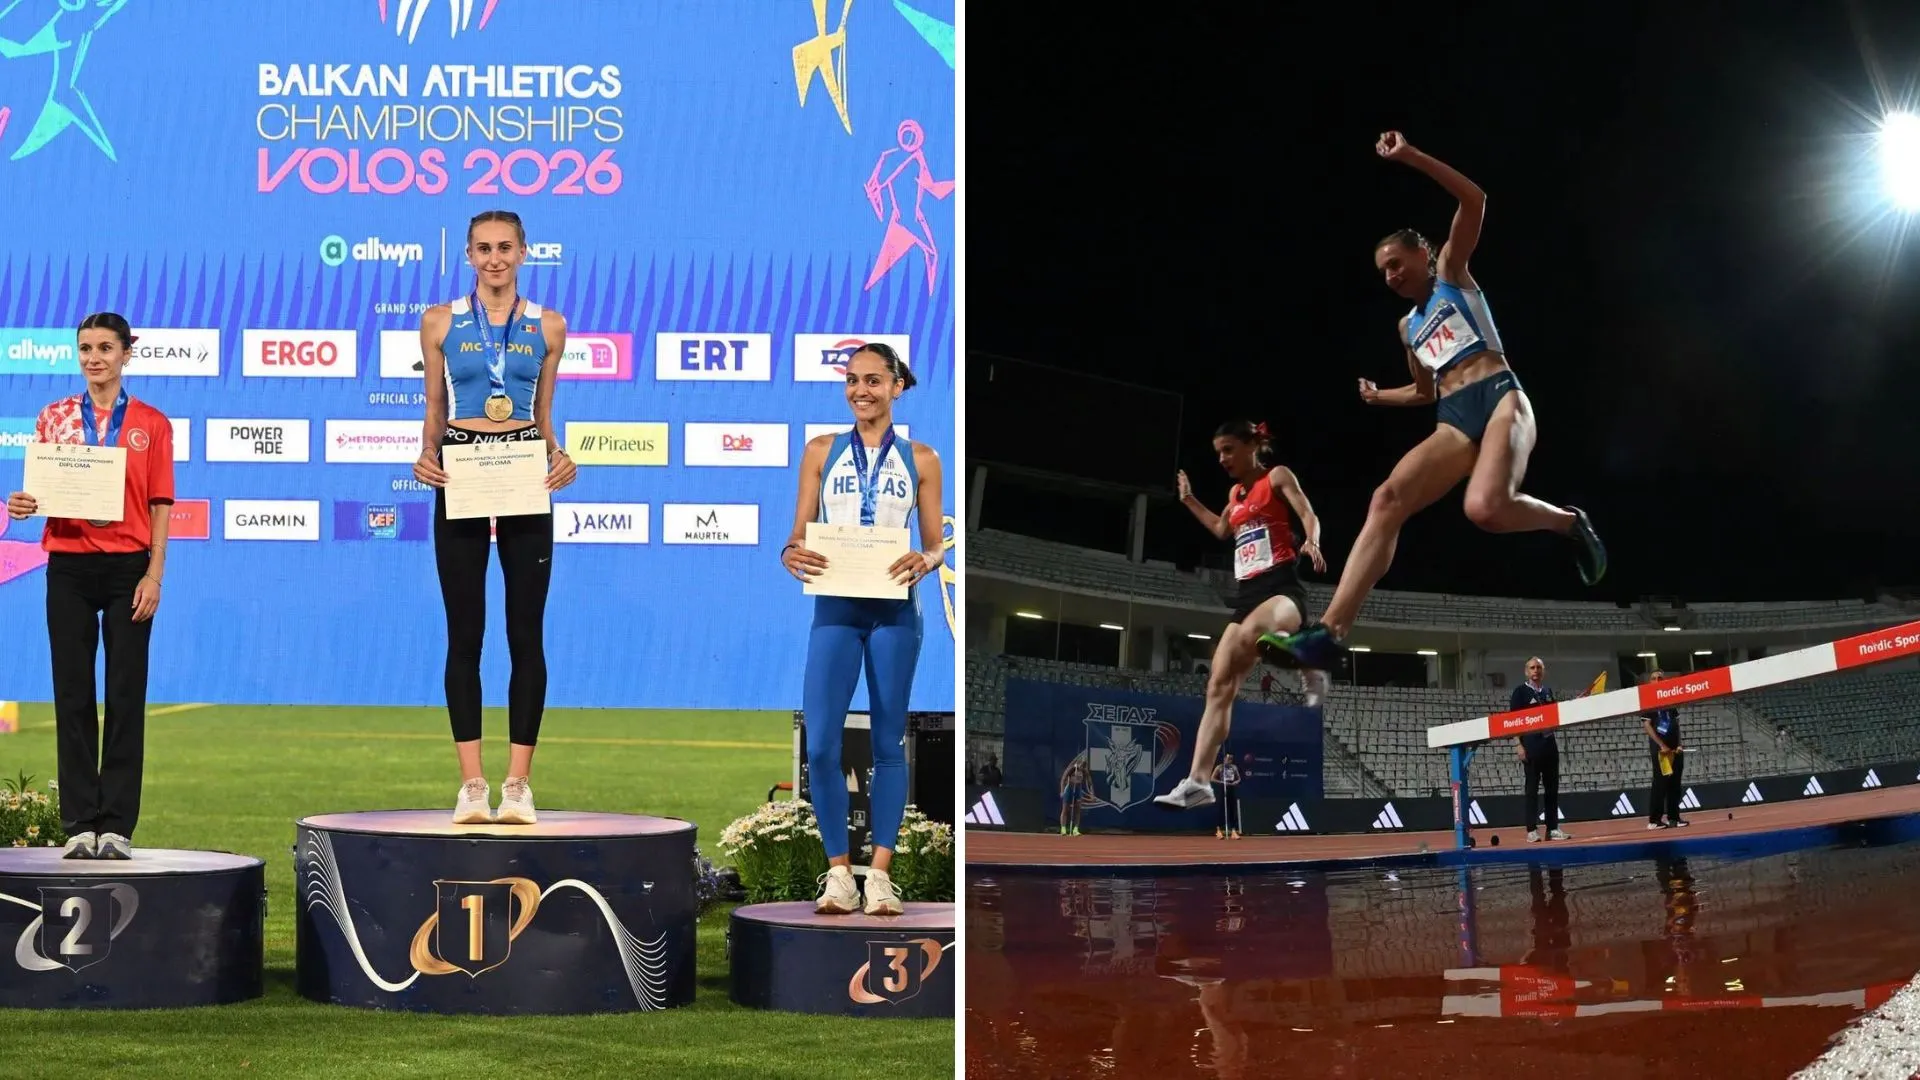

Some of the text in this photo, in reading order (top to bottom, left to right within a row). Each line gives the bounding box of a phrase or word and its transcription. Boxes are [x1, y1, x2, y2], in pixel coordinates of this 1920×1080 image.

[258, 63, 622, 99] BALKAN ATHLETICS
[256, 103, 624, 143] CHAMPIONSHIPS
[257, 147, 623, 196] VOLOS 2026
[352, 237, 424, 267] allwyn
[374, 303, 406, 314] GRAND
[460, 341, 533, 357] MODOVA
[1425, 324, 1456, 358] 174
[8, 338, 73, 367] allwyn
[132, 346, 191, 359] EGEAN
[261, 340, 338, 366] ERGO
[680, 339, 749, 371] ERT
[369, 393, 408, 405] OFFICIAL
[230, 426, 284, 440] POWER
[348, 435, 419, 444] METROPOLITAN
[722, 434, 753, 448] Dole
[254, 441, 284, 455] ADE
[598, 435, 655, 452] Piraeus
[833, 475, 907, 499] HEAS
[235, 514, 306, 528] GARMIN
[584, 514, 632, 530] AKMI
[684, 531, 729, 541] MAURTEN
[1685, 680, 1710, 695] Sport
[1524, 713, 1544, 726] Sport
[60, 896, 92, 955] 2
[461, 895, 484, 961] 1
[883, 947, 908, 993] 3
